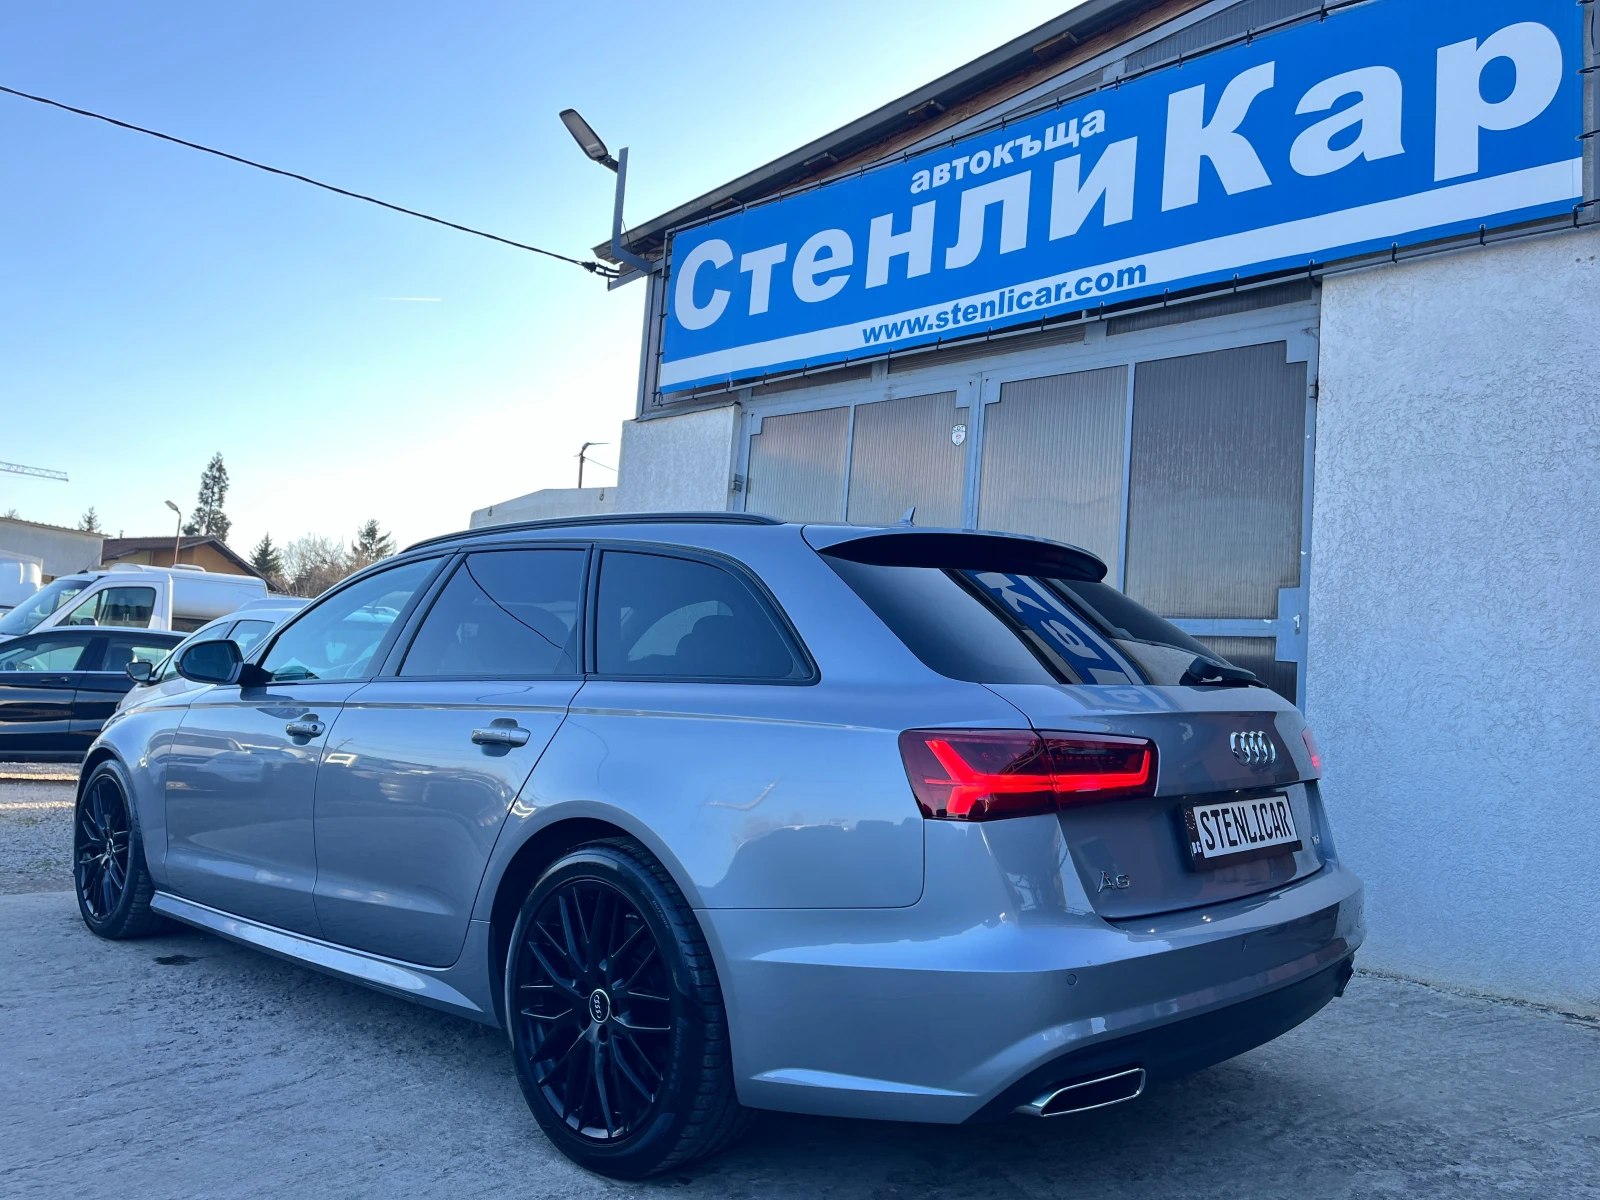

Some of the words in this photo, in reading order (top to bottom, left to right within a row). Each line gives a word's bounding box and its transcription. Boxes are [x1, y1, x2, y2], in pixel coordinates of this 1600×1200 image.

[910, 109, 1105, 194] автокъща
[862, 264, 1147, 344] www.stenlicar.com
[1191, 840, 1202, 854] BG
[1200, 801, 1292, 851] STENLICAR
[1097, 870, 1131, 893] A6
